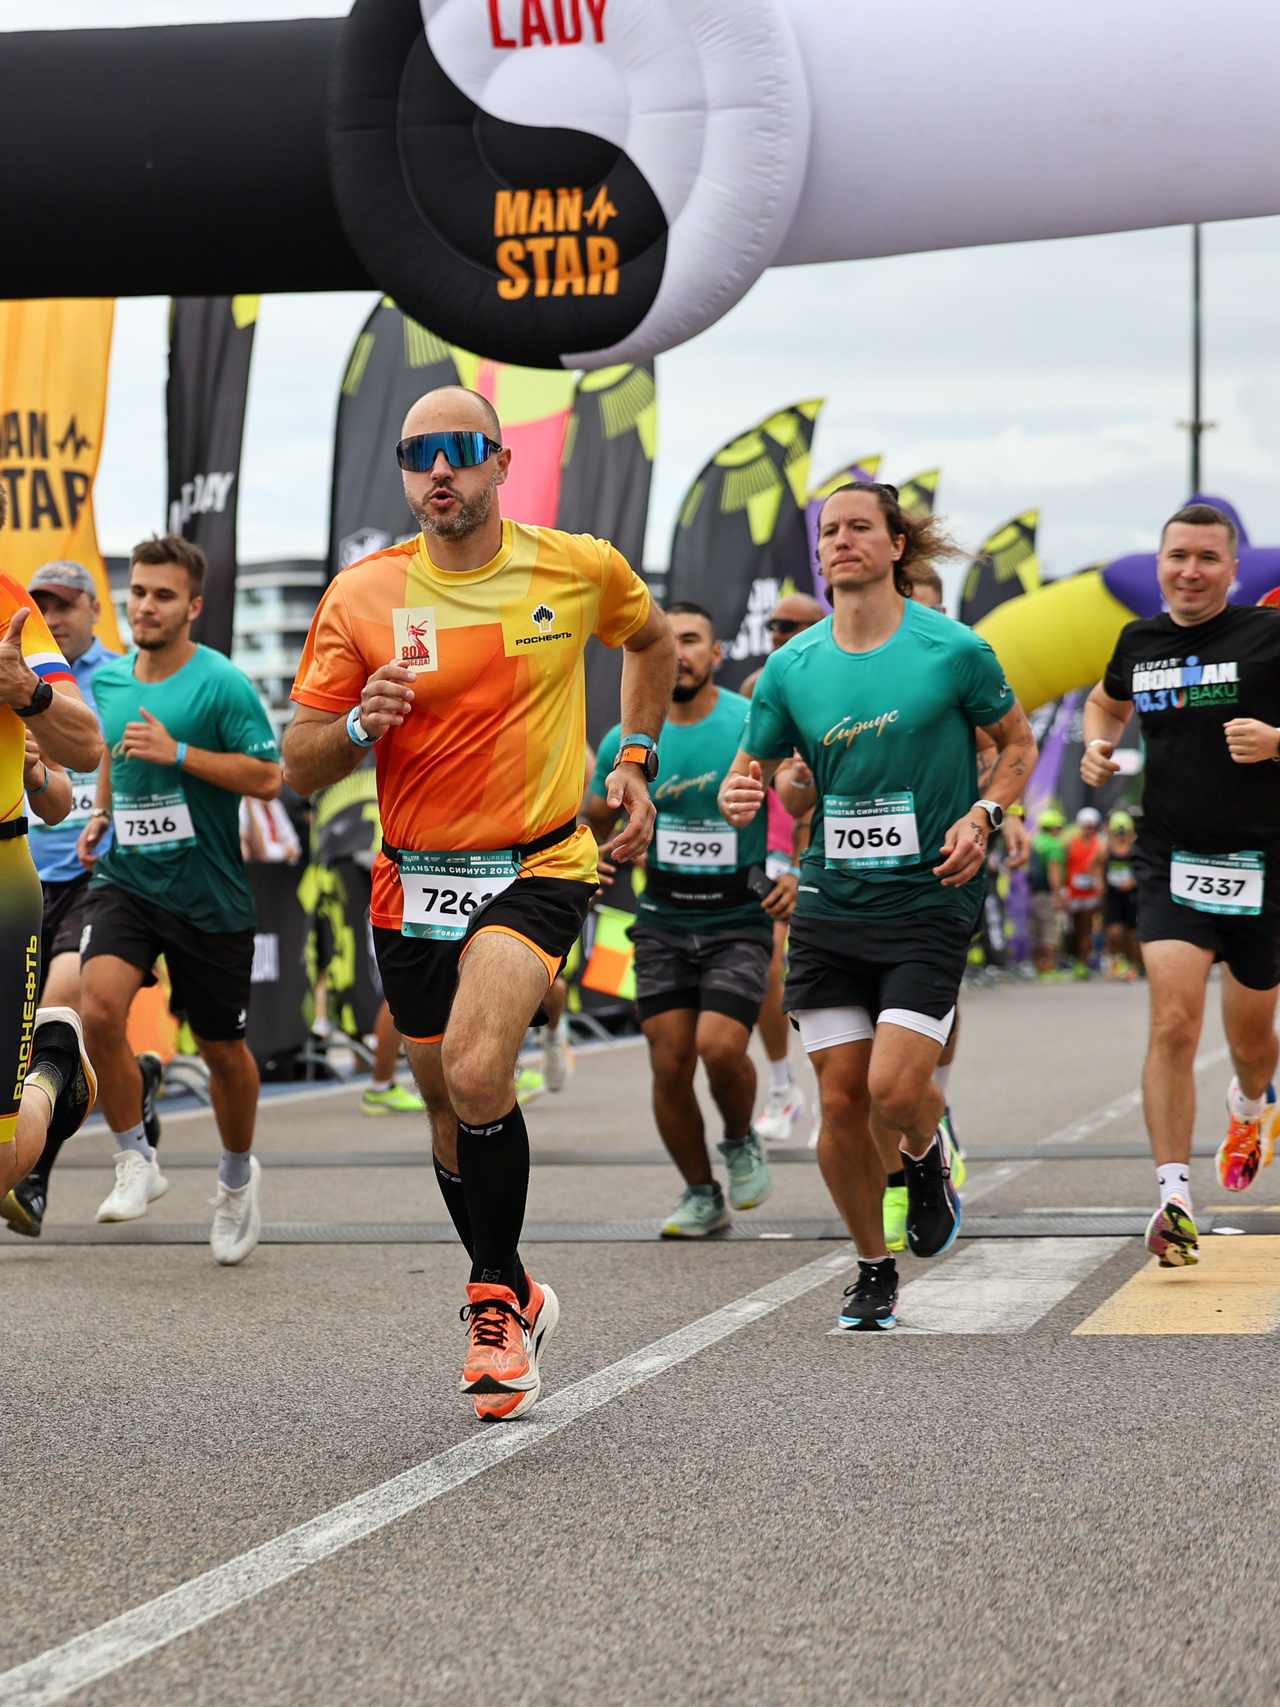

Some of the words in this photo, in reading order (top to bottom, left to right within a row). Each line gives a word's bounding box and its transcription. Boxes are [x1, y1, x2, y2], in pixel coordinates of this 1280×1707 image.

[488, 0, 608, 49] LADY
[494, 187, 583, 238] MAN
[496, 234, 620, 301] STAR
[1, 468, 90, 530] TAR
[515, 631, 572, 646] РОСНЕФТЬ
[401, 645, 418, 658] 80
[407, 658, 431, 667] ОБЕДА!
[1132, 659, 1239, 692] IRONMAN
[1133, 689, 1168, 713] 70.3
[1189, 683, 1239, 700] BAKU
[823, 709, 899, 748] Сириус
[856, 807, 889, 816] СИРИУС
[124, 816, 177, 837] 7316
[666, 840, 723, 858] 7299
[834, 826, 902, 850] 7056
[402, 865, 447, 873] MANSTAR
[449, 866, 487, 875] СИРИУС
[489, 867, 515, 875] 2026
[1185, 874, 1246, 897] 7337
[13, 934, 38, 1101] РОСНЕФТЬ
[460, 1123, 503, 1137] cep
[439, 1170, 462, 1183] ce
